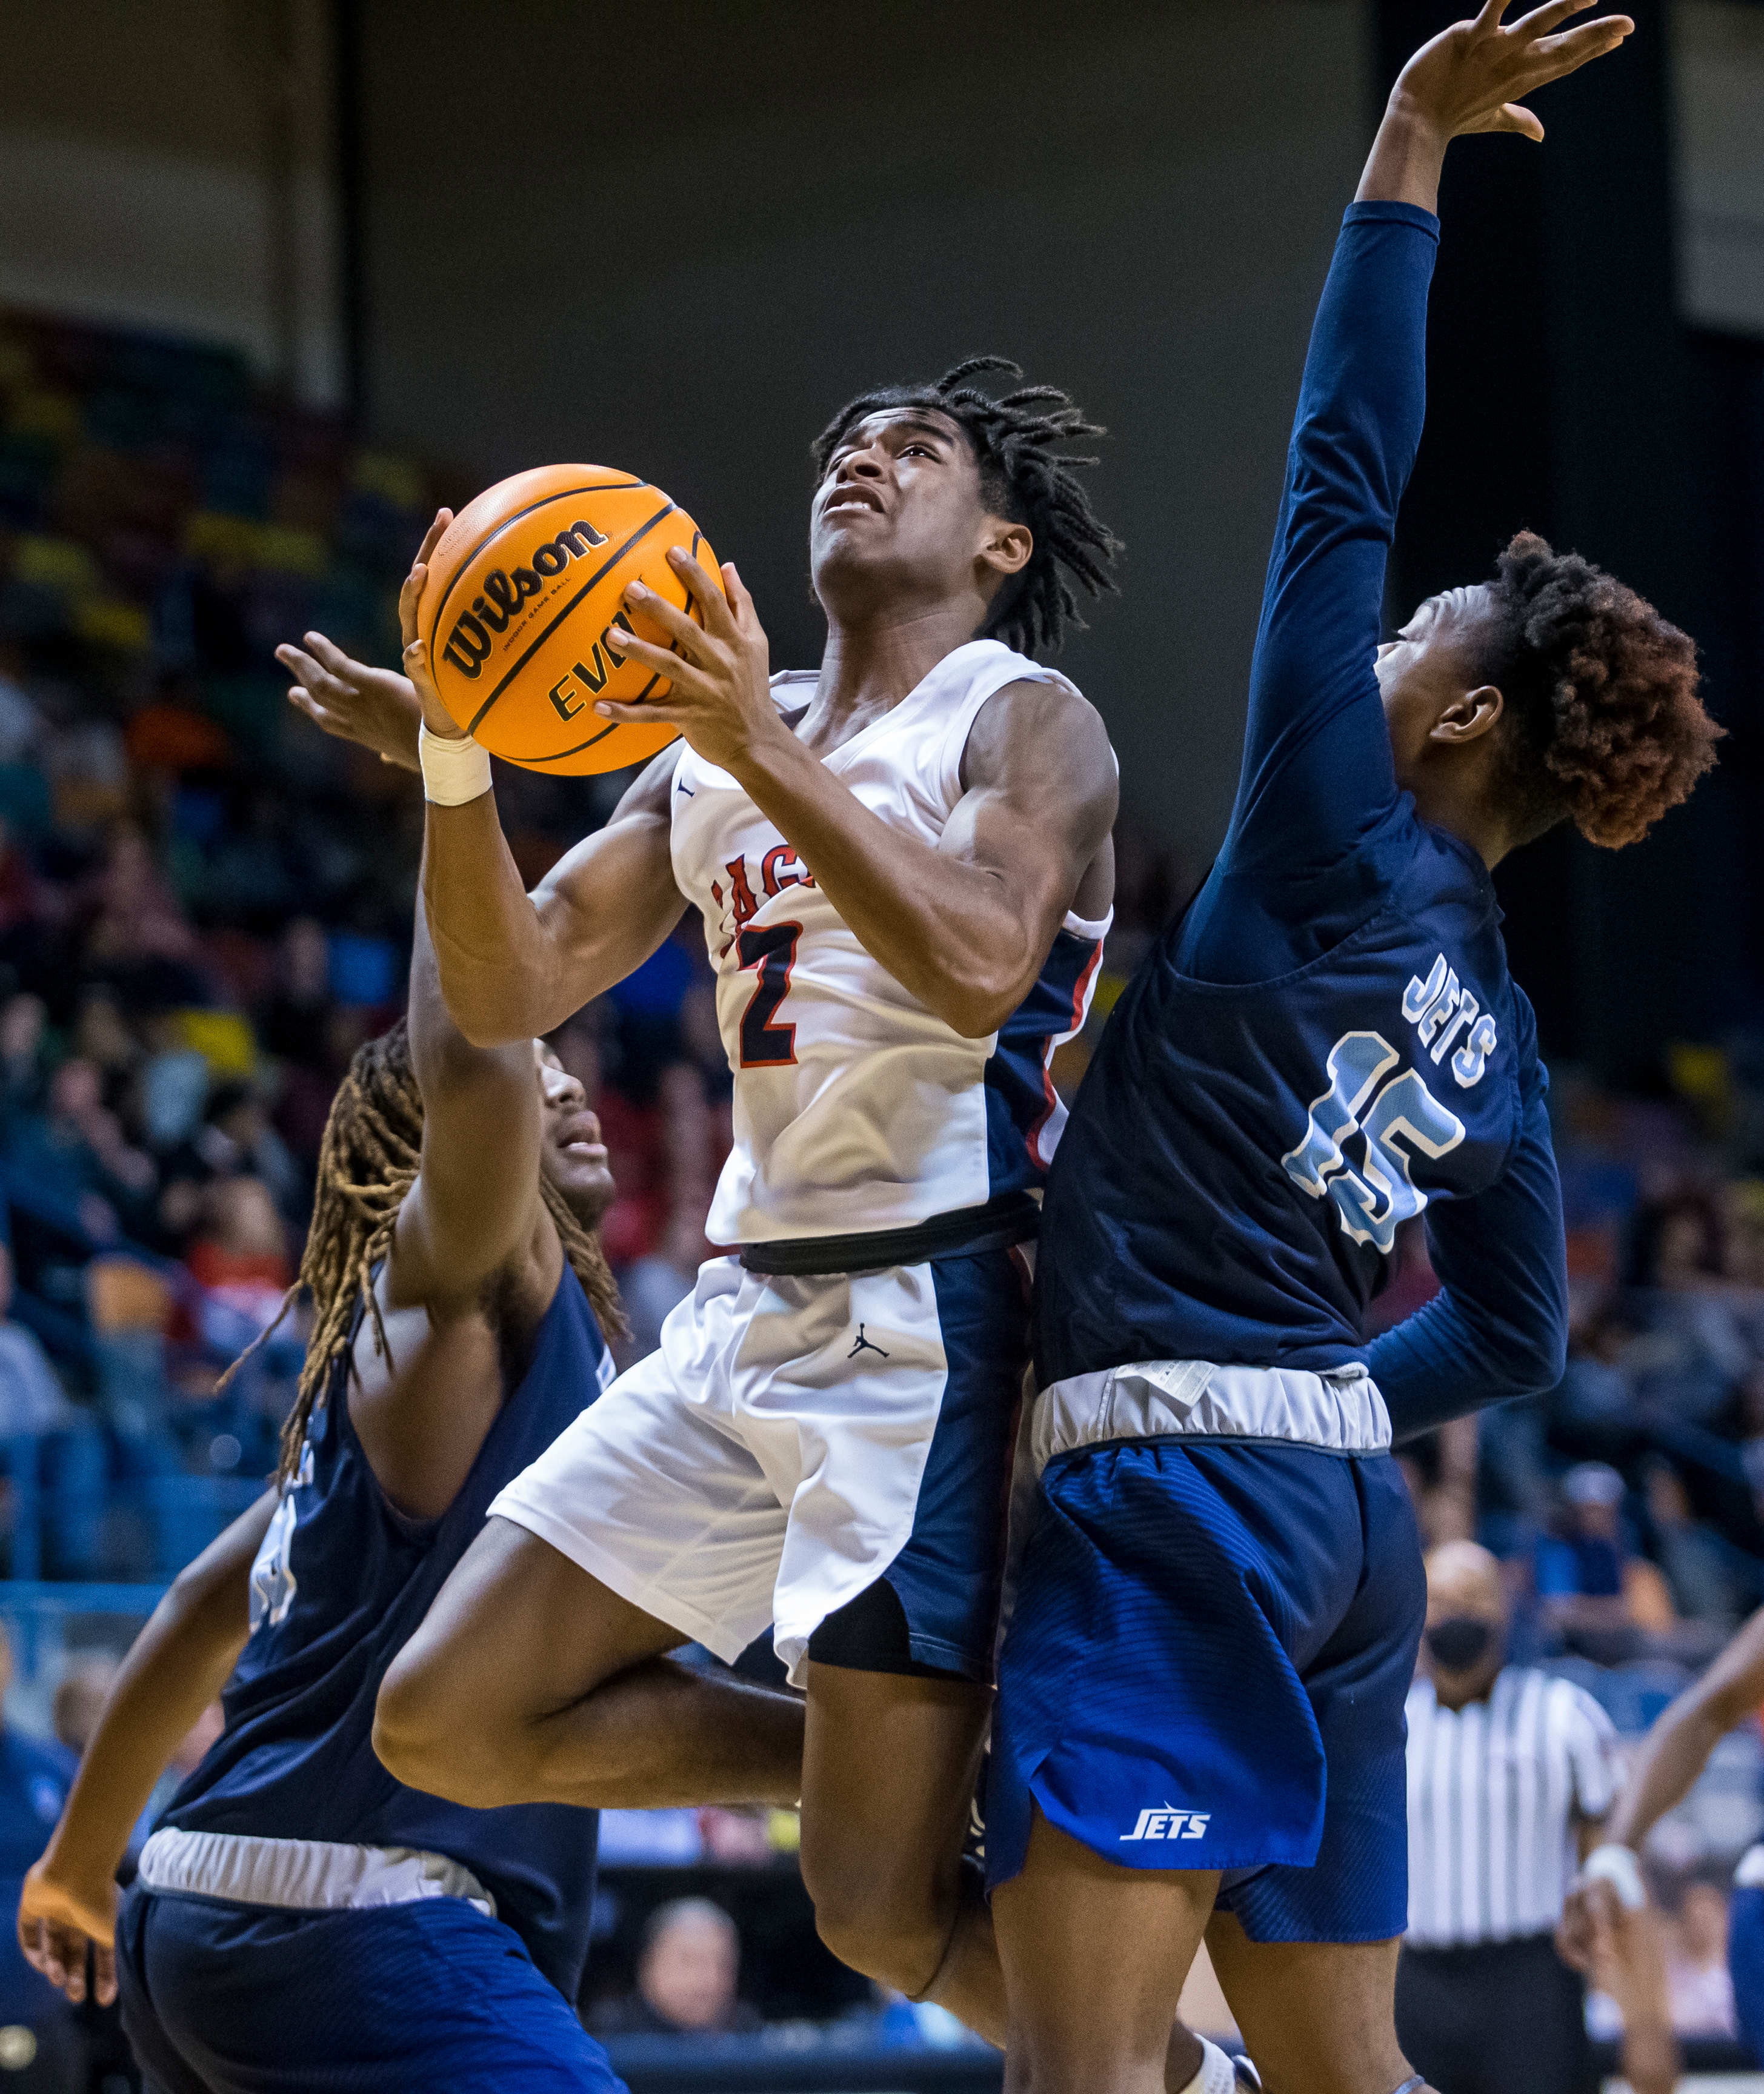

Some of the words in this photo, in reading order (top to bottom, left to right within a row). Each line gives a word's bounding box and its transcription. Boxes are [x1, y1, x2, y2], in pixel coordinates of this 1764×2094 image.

[442, 520, 608, 679] Wilson
[503, 620, 527, 651] INDOOR
[528, 596, 550, 619] GAME
[550, 577, 571, 595] BALL
[735, 920, 804, 1069] 2
[1402, 952, 1497, 1088] JETS
[1281, 1031, 1465, 1255] 15
[1119, 1800, 1211, 1841] JETS
